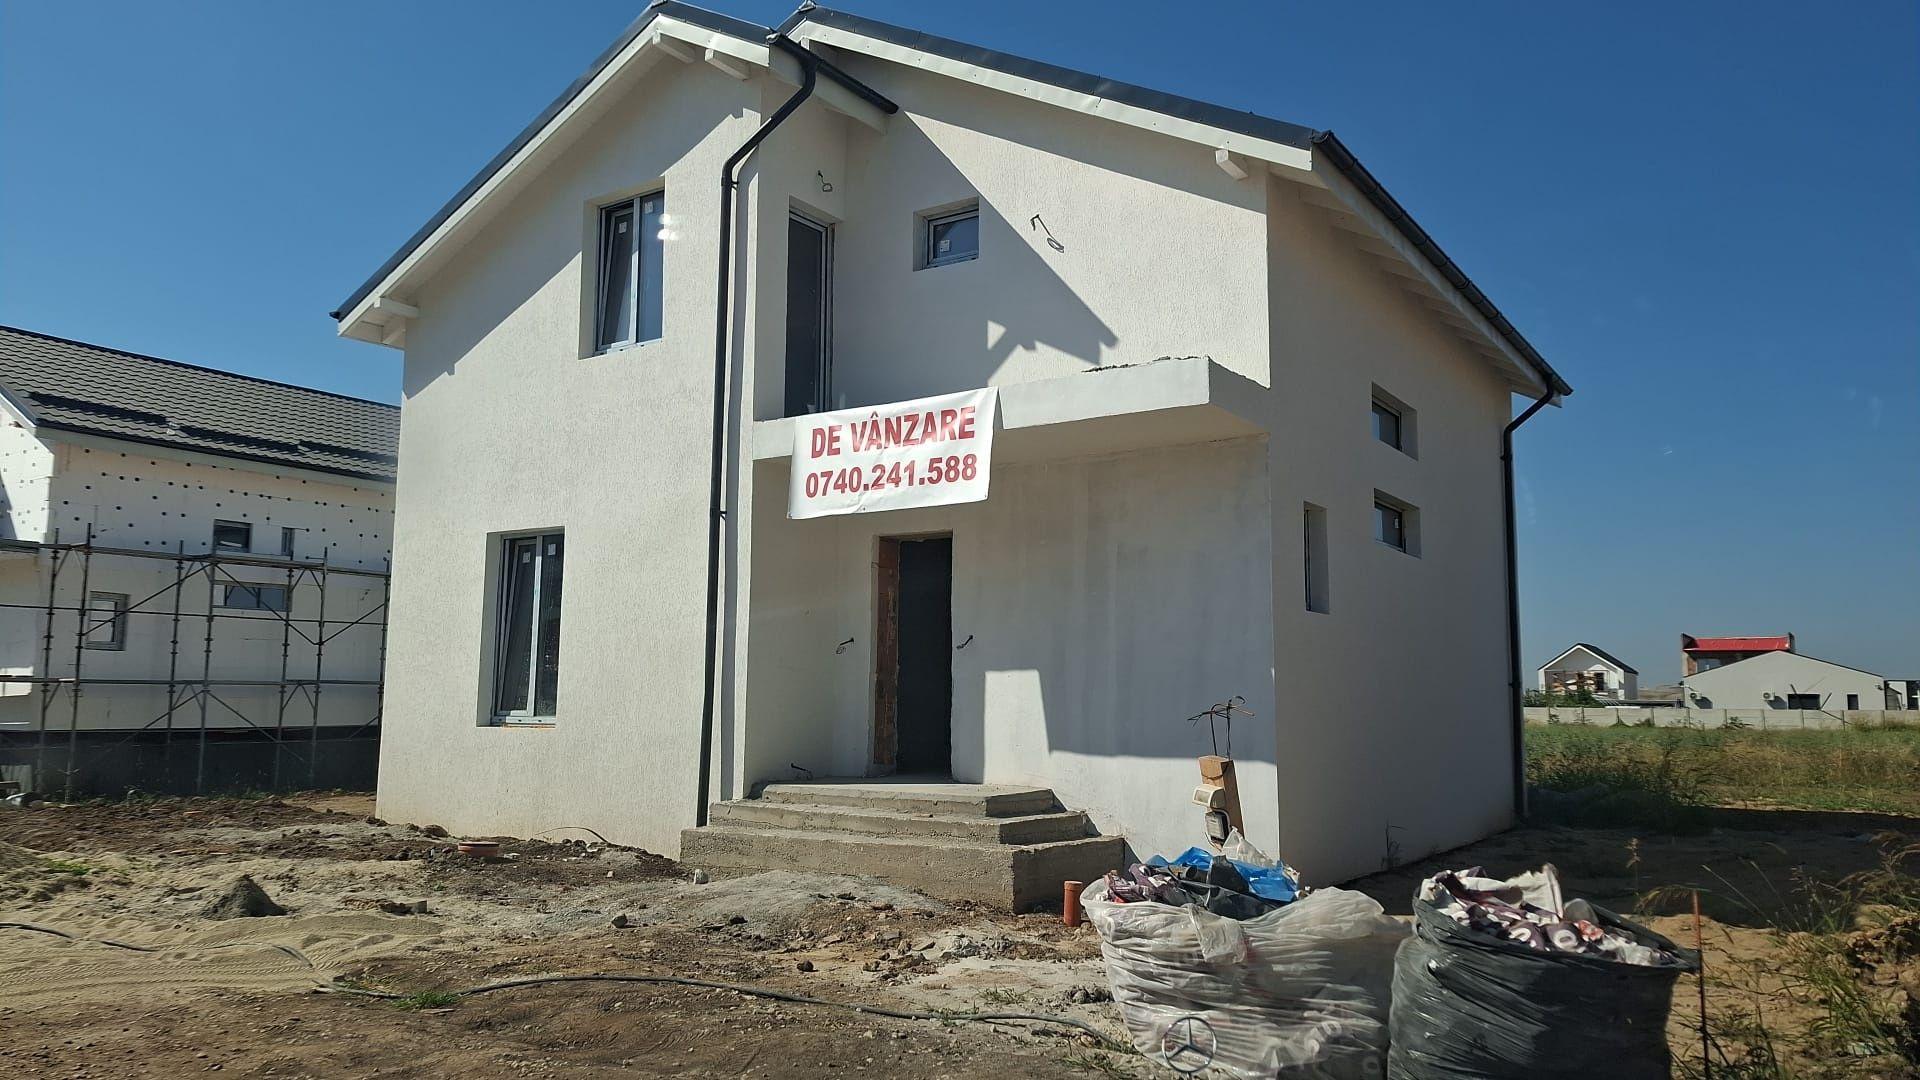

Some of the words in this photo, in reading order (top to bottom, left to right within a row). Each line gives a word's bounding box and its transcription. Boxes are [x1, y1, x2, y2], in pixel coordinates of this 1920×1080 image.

[811, 425, 842, 458] DE
[850, 406, 976, 452] VÂNZARE
[805, 454, 977, 498] 0740.241.588
